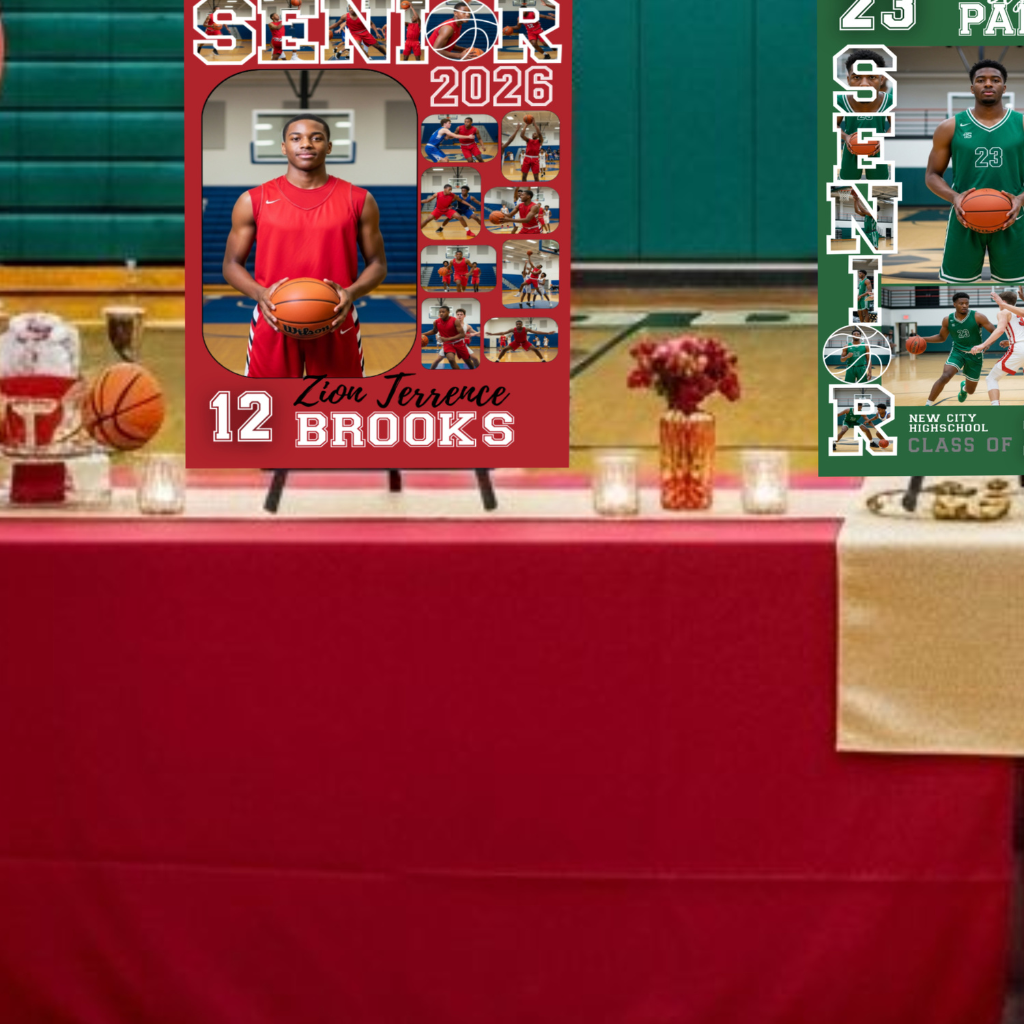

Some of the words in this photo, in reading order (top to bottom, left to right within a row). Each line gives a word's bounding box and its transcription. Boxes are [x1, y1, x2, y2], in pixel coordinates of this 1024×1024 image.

[429, 65, 554, 108] 2026
[974, 146, 1004, 168] 23
[282, 323, 330, 336] Wilson
[293, 375, 368, 407] Zion
[376, 371, 511, 408] Terrence
[209, 389, 274, 443] 12
[908, 413, 942, 423] NEW
[946, 413, 977, 423] CITY
[294, 410, 515, 448] BROOKS
[908, 423, 989, 433] HIGHSCHOOL
[907, 437, 975, 453] CLASS
[986, 437, 1013, 452] OF
